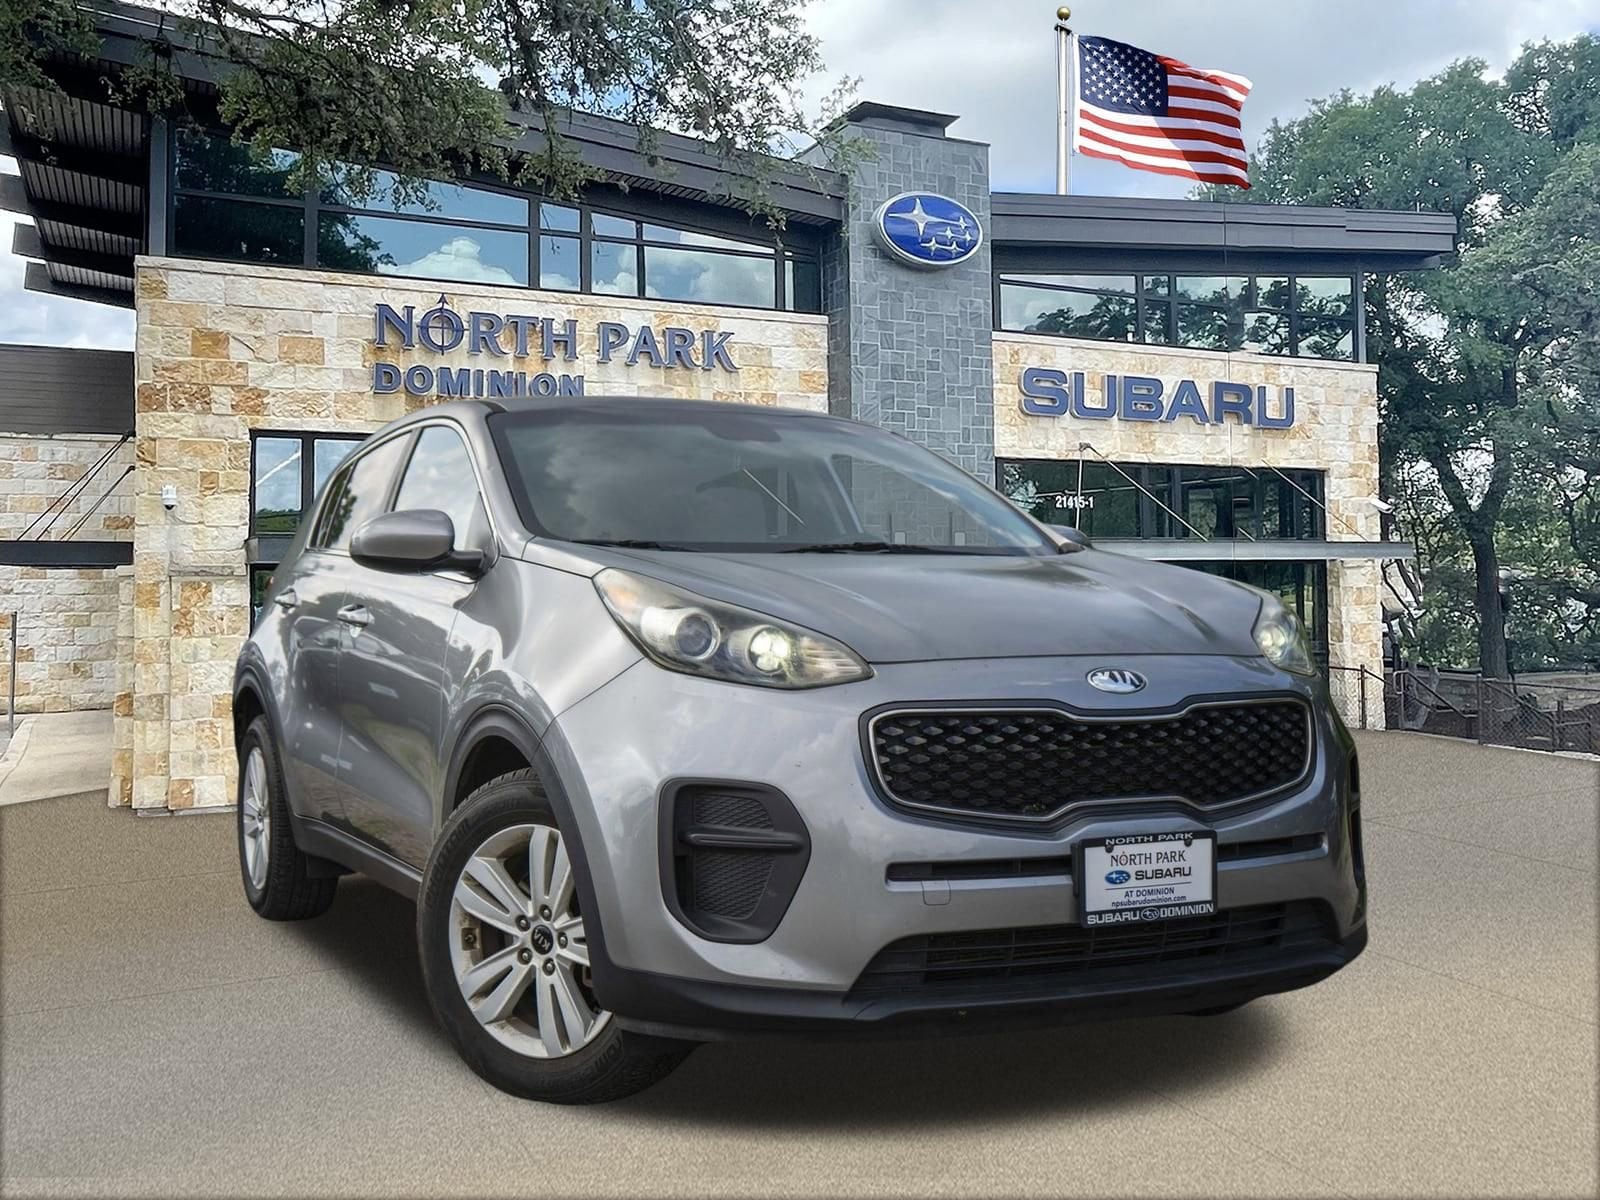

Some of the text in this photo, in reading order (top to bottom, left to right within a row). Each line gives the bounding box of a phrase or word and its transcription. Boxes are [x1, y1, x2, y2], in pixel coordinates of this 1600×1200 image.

[374, 299, 741, 373] NORTH PARK
[373, 362, 585, 397] DOMINION
[1019, 367, 1295, 429] SUBARU
[1105, 832, 1194, 846] NORTH PARK
[1110, 850, 1186, 867] NORTH PARK
[1135, 866, 1192, 881] SUBARU
[1111, 895, 1187, 908] npsubarudominion.com
[1124, 887, 1175, 899] AT DOMINION
[1087, 903, 1214, 925] SUBARU DOMINION
